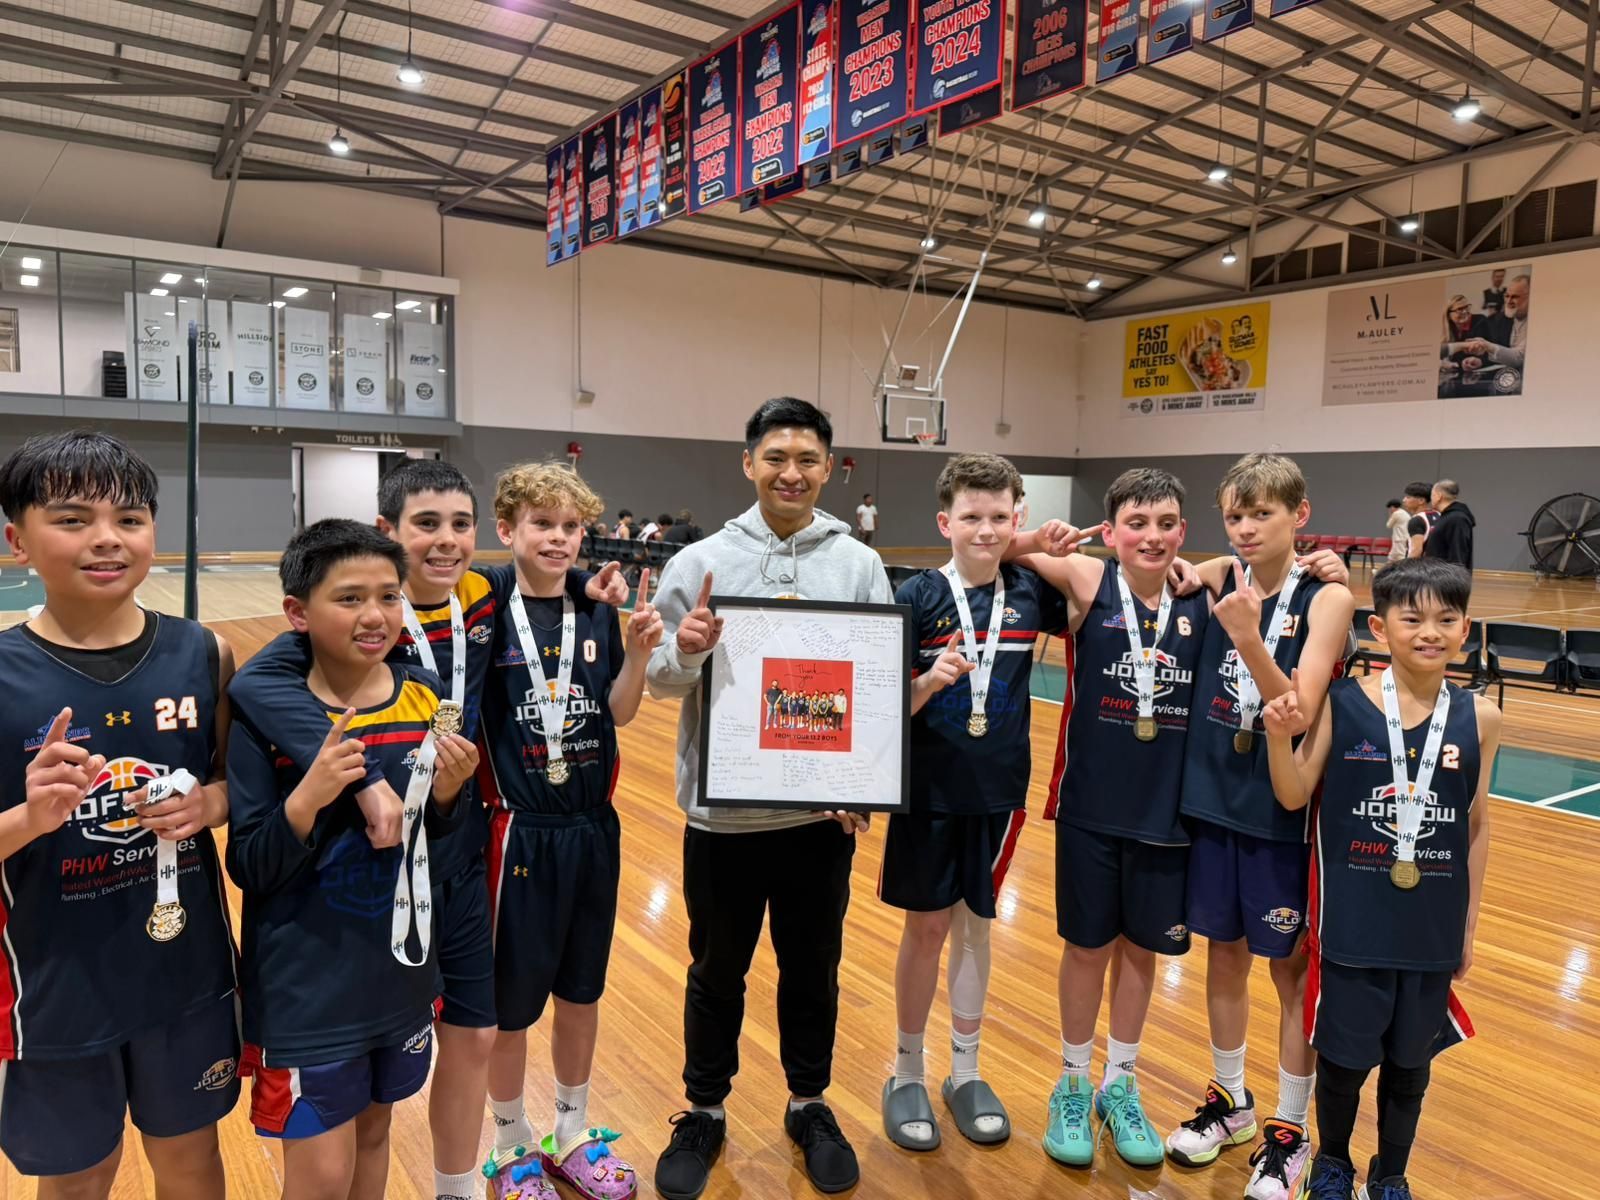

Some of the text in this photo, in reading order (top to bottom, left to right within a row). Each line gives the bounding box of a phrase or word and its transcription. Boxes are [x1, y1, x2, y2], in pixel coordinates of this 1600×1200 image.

[860, 17, 884, 45] MEN
[924, 0, 991, 46] CHAMPIONS
[1032, 7, 1068, 40] 2006
[1115, 13, 1138, 31] GIRLS
[806, 42, 827, 65] STATE
[844, 29, 902, 75] CHAMPIONS
[931, 24, 982, 75] 2024
[1022, 42, 1077, 76] CHAMPIONS
[802, 56, 831, 82] CHAMPS
[849, 55, 894, 102] 2023
[745, 101, 793, 140] CHAMPIONS
[752, 127, 784, 164] 2022
[698, 151, 726, 185] 2022
[1137, 324, 1169, 342] FAST
[1356, 326, 1404, 339] MAULEY
[294, 345, 322, 355] STONE
[1136, 340, 1168, 356] FOOD
[1128, 353, 1176, 370] ATHLETES
[1145, 368, 1157, 376] SAY
[1133, 375, 1169, 389] YES TO!
[1185, 401, 1202, 410] AWAY
[1220, 398, 1237, 406] MINS
[336, 434, 376, 445] TOILETS
[1176, 615, 1193, 637] 6
[1281, 614, 1301, 639] 21
[583, 639, 597, 663] 0
[795, 663, 817, 675] Thank
[1102, 662, 1193, 684] JOOW
[154, 695, 198, 732] 24
[515, 699, 601, 722] JOOW
[1100, 695, 1189, 717] PHW Srvices
[561, 739, 600, 752] ervices
[774, 732, 792, 740] FROM
[793, 733, 810, 741] YOUR
[1441, 743, 1460, 770] 2
[64, 790, 138, 821] OFL
[1352, 800, 1456, 823] JOFOW
[61, 837, 197, 876] PHW Serves
[1349, 840, 1452, 860] PHW Srvices
[101, 879, 134, 896] Electrical
[138, 874, 151, 884] Air
[193, 1063, 236, 1091] JOFLO
